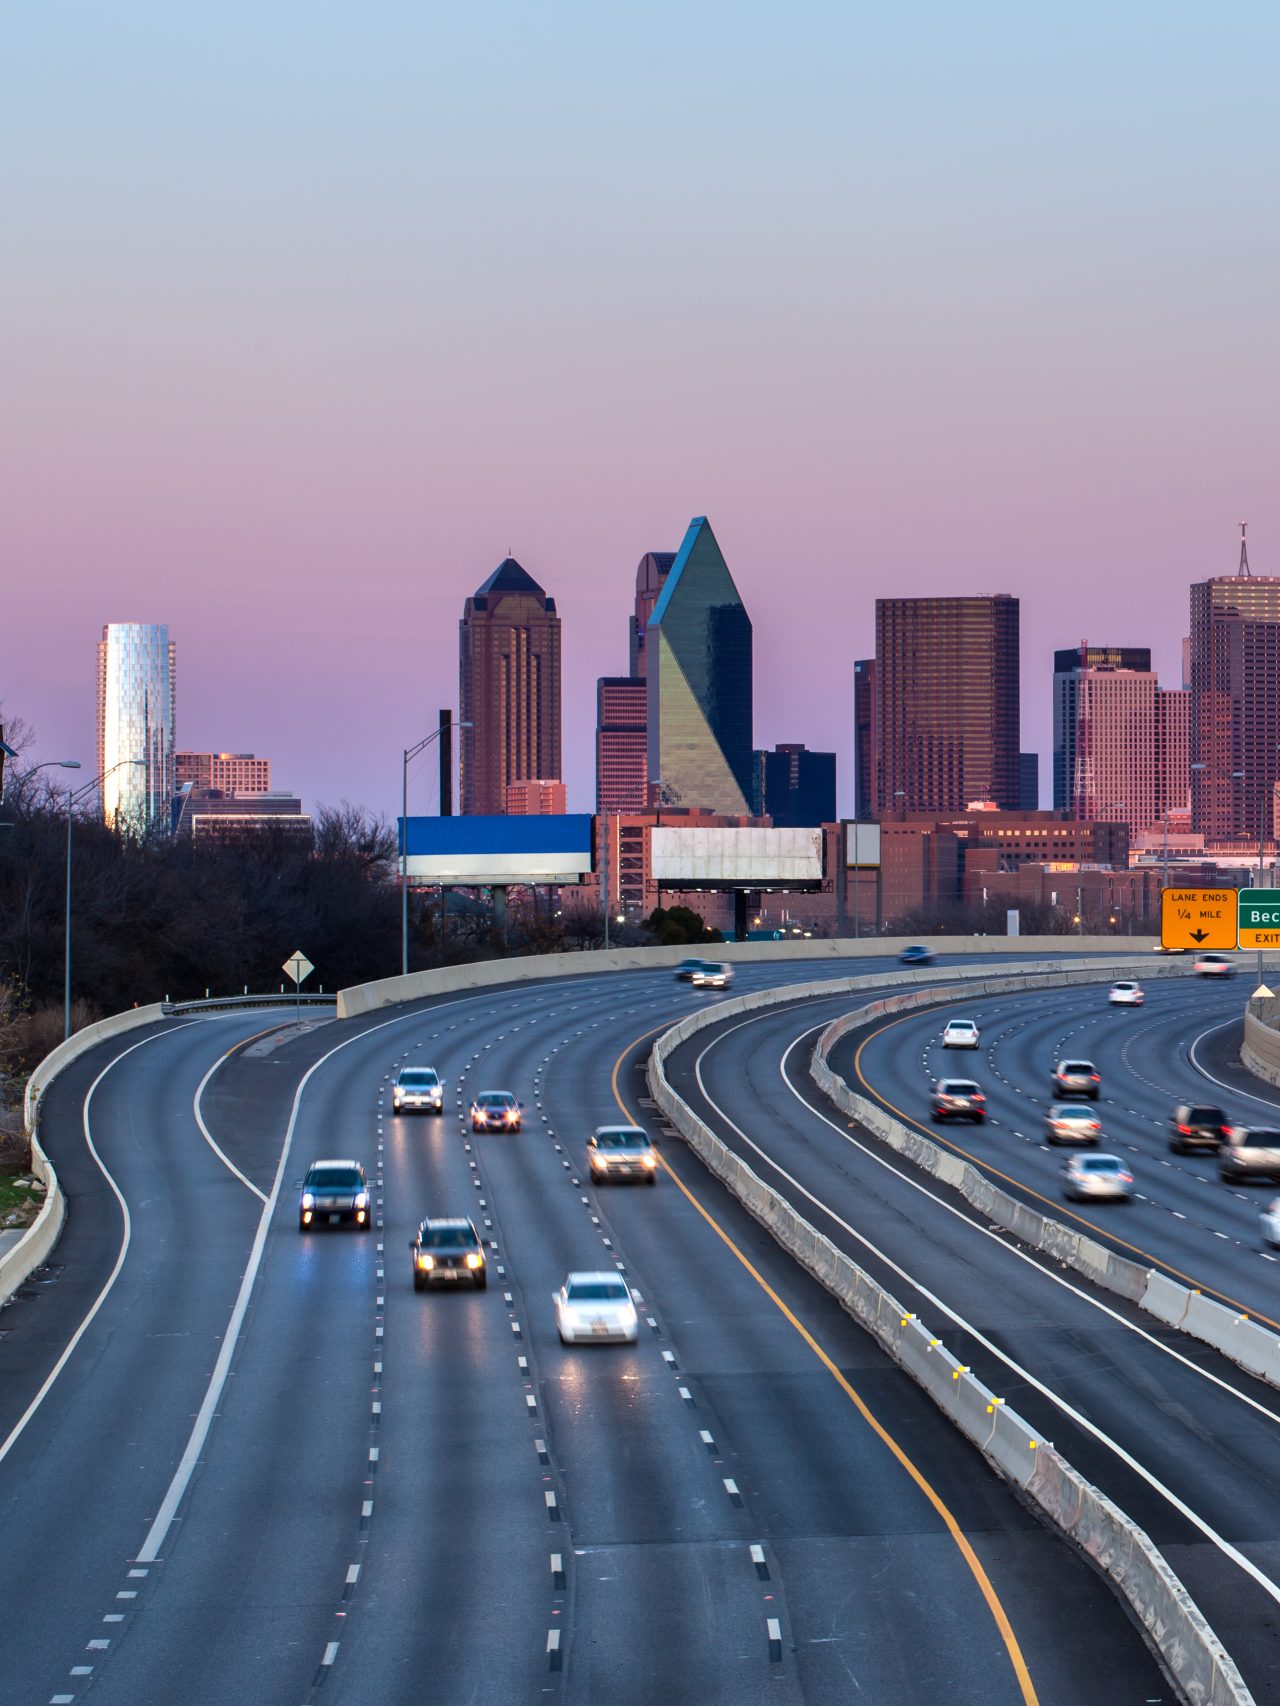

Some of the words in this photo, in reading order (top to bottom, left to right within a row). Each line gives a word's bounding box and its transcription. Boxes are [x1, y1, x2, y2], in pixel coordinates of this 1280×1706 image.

[1171, 893, 1197, 902] LANE
[1202, 893, 1228, 902] ENDS
[1199, 910, 1222, 919] MILE
[1255, 933, 1280, 943] EXIT
